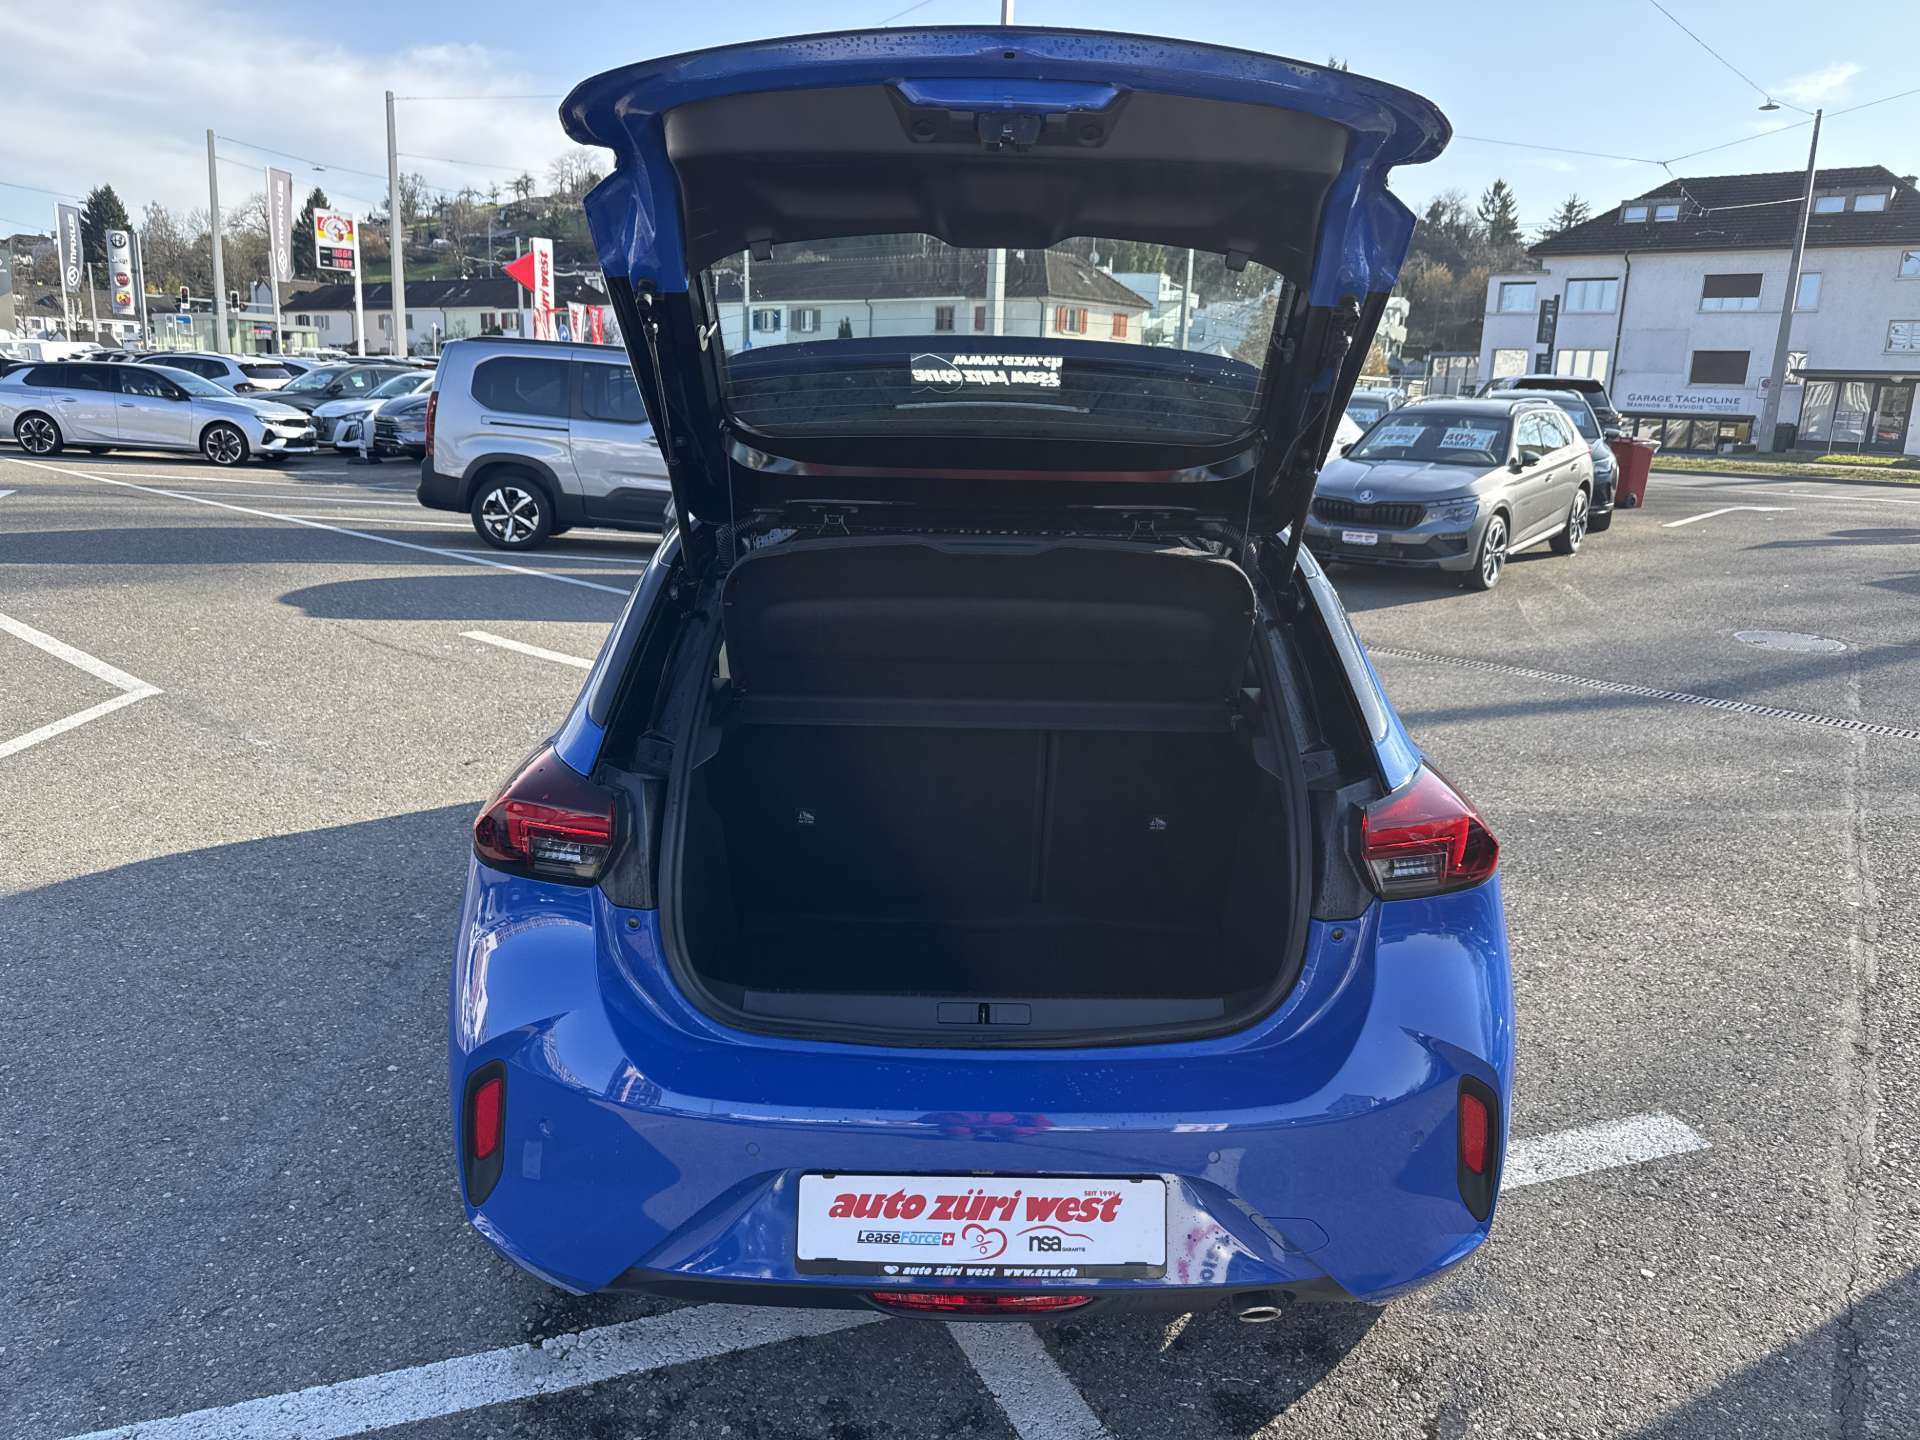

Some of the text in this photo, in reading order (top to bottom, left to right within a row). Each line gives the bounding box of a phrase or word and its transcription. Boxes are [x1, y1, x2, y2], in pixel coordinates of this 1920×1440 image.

[1627, 392, 1741, 405] GARAGE TACHOLINE
[1445, 432, 1477, 442] 40%
[828, 1188, 1123, 1222] auto züri west
[857, 1230, 942, 1245] LeaseForce
[1028, 1235, 1061, 1252] nsa
[902, 1265, 932, 1275] auto
[966, 1266, 995, 1277] west
